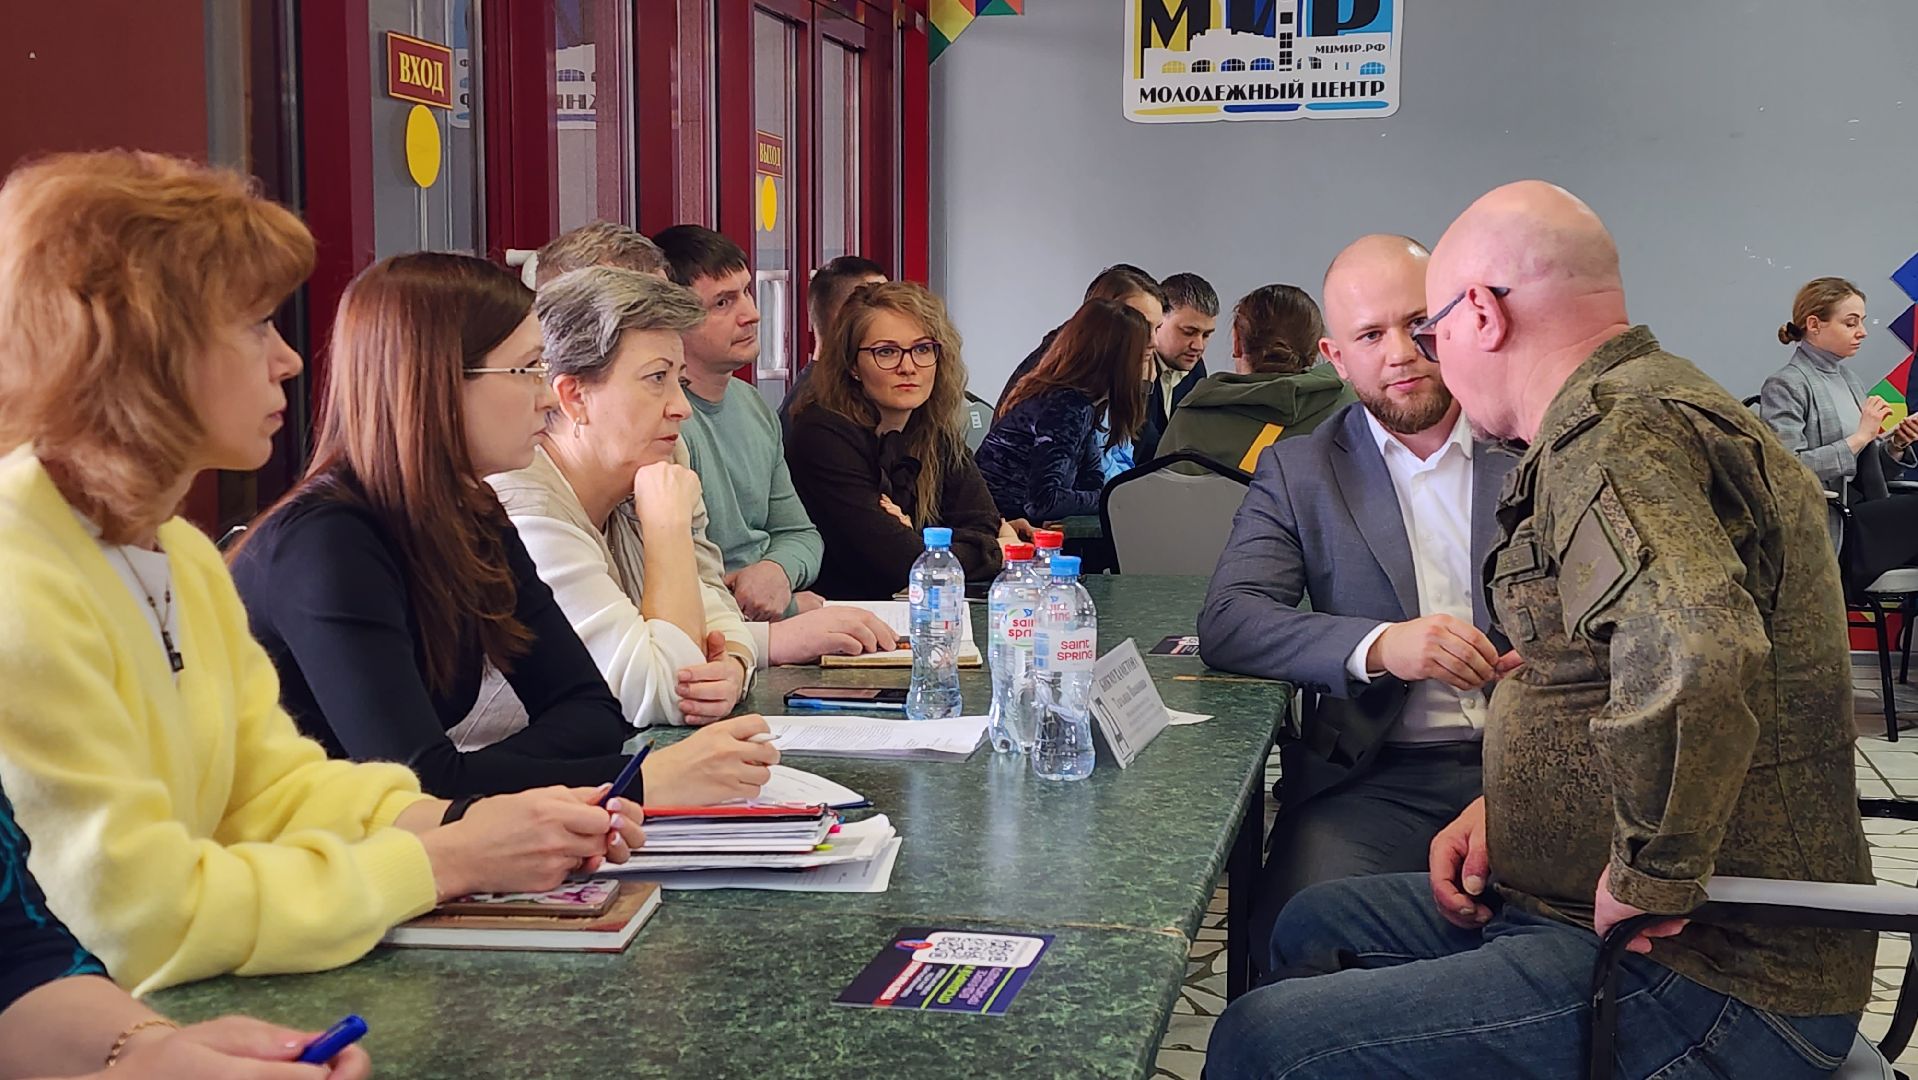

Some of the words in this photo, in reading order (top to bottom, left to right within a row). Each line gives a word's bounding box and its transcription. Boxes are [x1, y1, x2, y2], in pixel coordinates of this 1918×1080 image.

[1314, 43, 1386, 54] МЦМИР.РФ
[399, 52, 444, 97] ВХОД
[1139, 79, 1304, 104] МОЛОДЕЖНЫЙ
[1311, 80, 1386, 98] ЦЕНТР
[1008, 629, 1032, 641] spri
